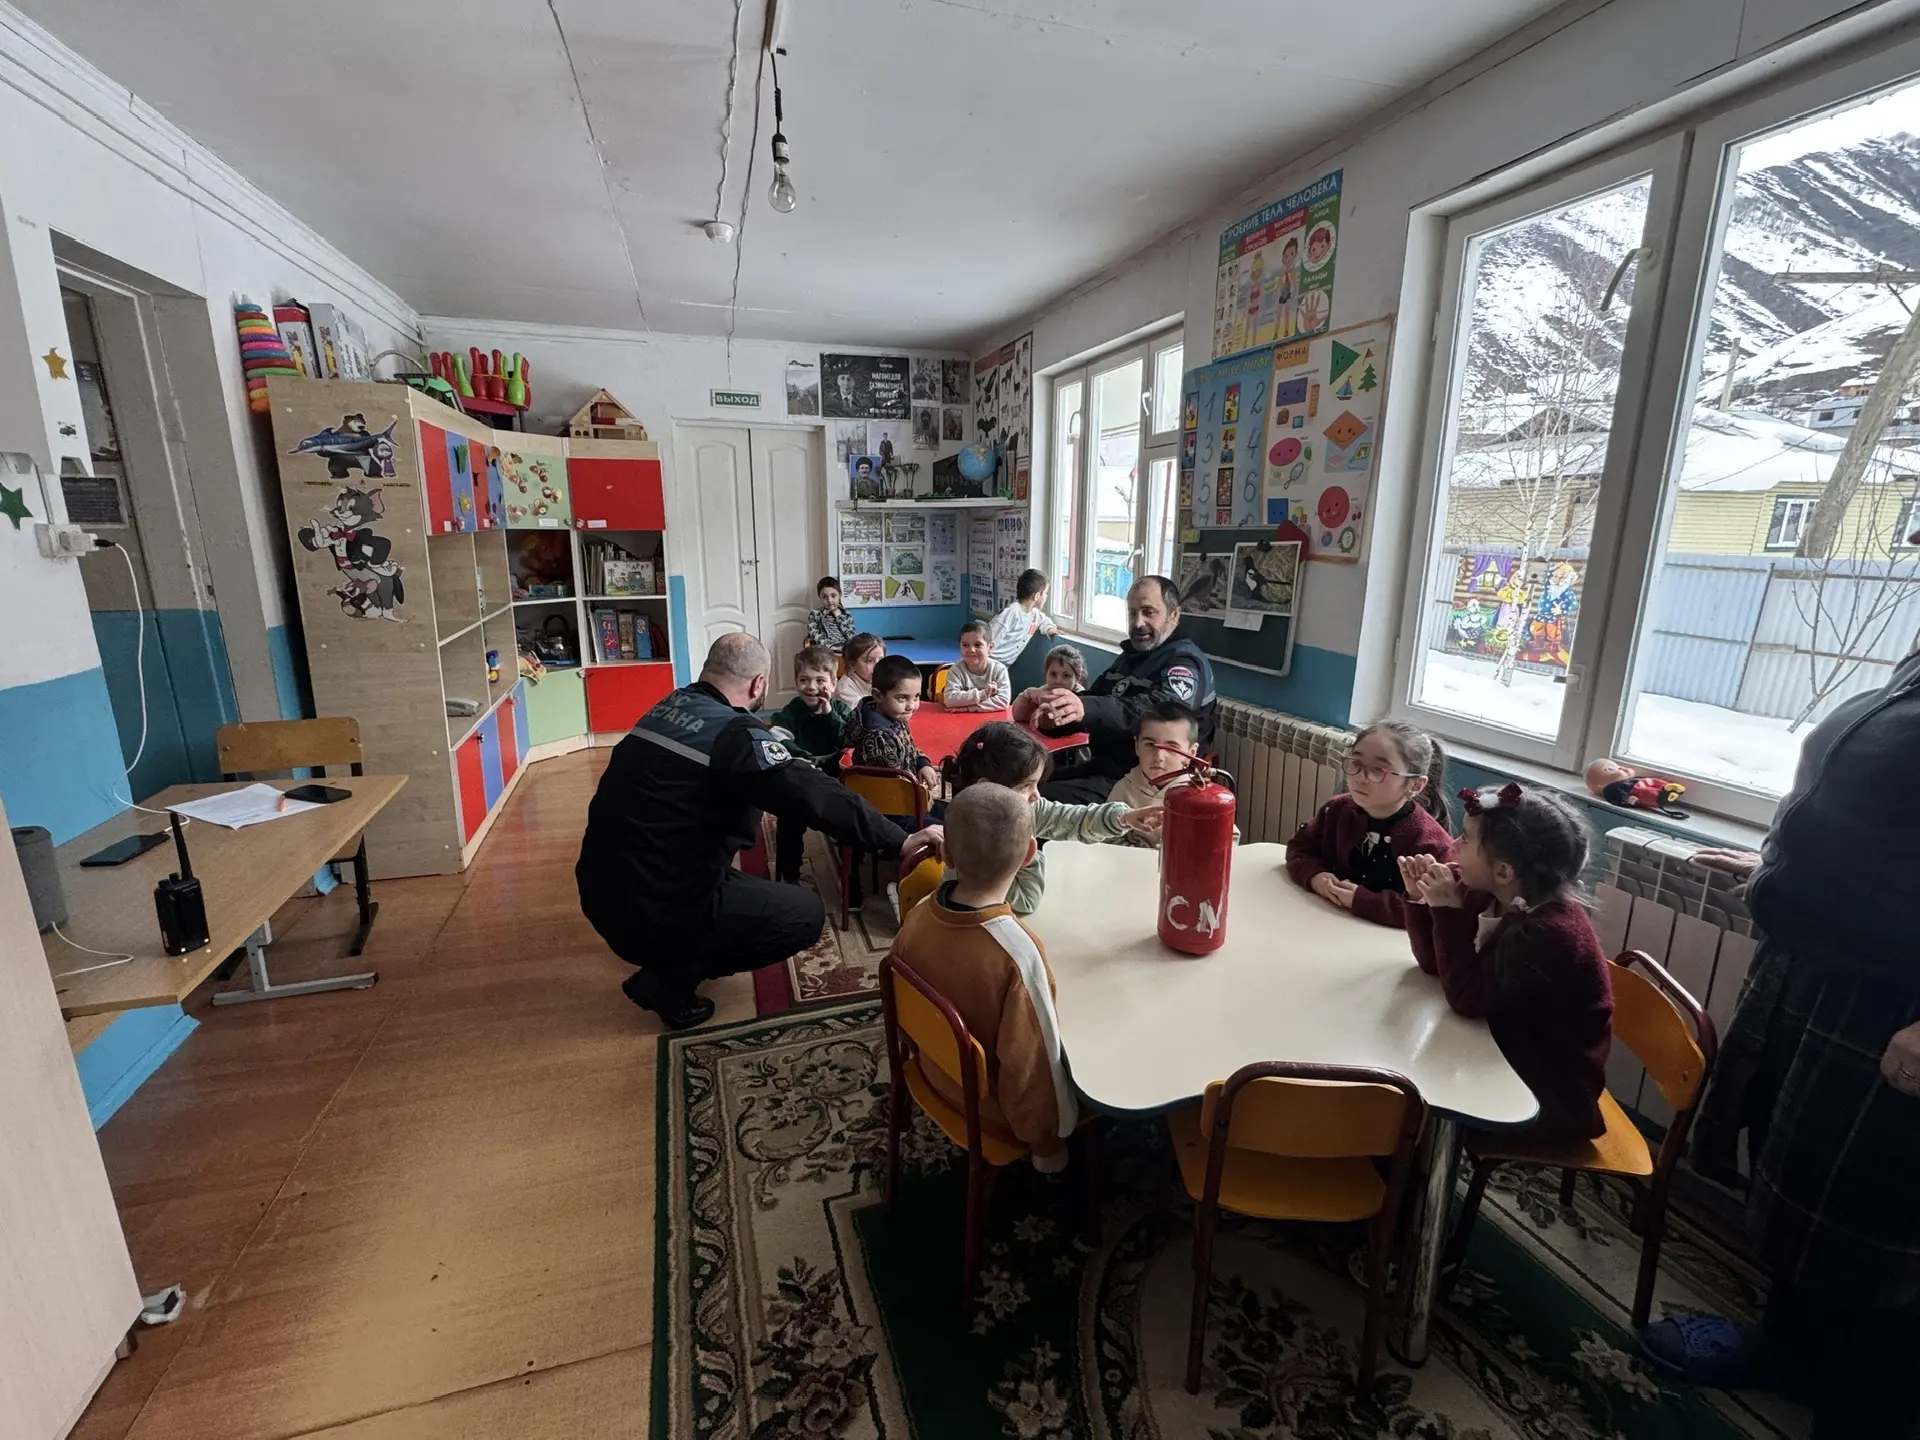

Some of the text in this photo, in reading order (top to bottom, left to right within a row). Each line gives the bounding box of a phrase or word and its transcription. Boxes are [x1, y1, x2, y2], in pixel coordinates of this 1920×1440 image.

[1261, 204, 1283, 223] ТЕЛА
[1286, 175, 1337, 209] ЧЕЛОВЕКА
[1276, 347, 1307, 361] ФОРМА
[716, 395, 758, 405] ВЫХОД
[1205, 391, 1216, 421] 1
[1250, 381, 1265, 415] 2
[1202, 432, 1213, 464] 3
[1246, 427, 1261, 459] 4
[1198, 472, 1211, 504] 5
[1244, 471, 1257, 502] 6
